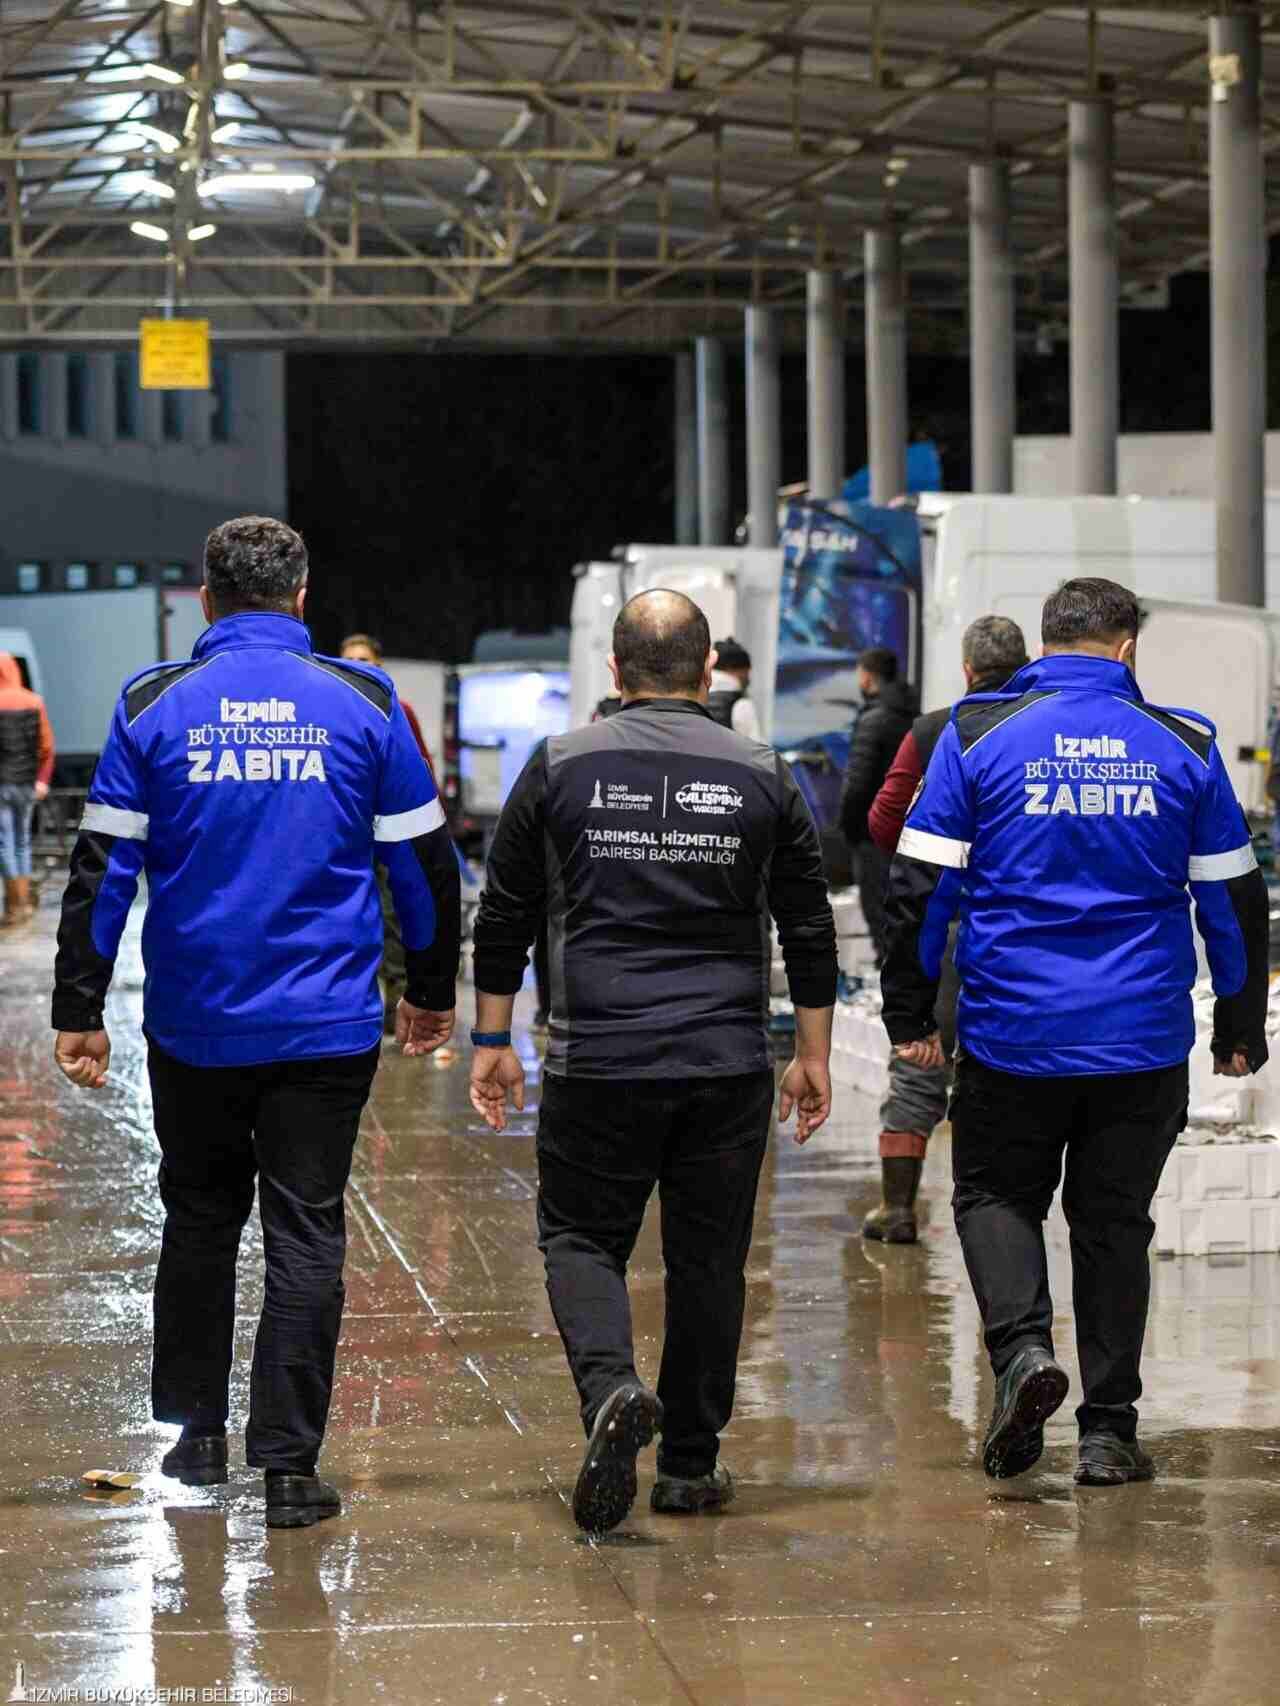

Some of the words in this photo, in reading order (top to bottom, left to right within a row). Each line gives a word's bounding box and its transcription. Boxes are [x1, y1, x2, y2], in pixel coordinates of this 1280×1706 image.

[220, 698, 296, 723] İZMİR
[187, 723, 331, 748] BÜYÜKŞEHİR
[1055, 733, 1128, 758] İZMİR
[187, 750, 327, 782] ZABITA
[1024, 758, 1160, 783] BÜYÜKŞEHİR
[1024, 784, 1159, 816] ZABITA
[584, 829, 659, 845] TARIMSAL
[662, 829, 741, 849] HİZMETLER
[589, 844, 645, 860] DAİRESİ
[649, 848, 736, 865] BAŞKANLIĞI
